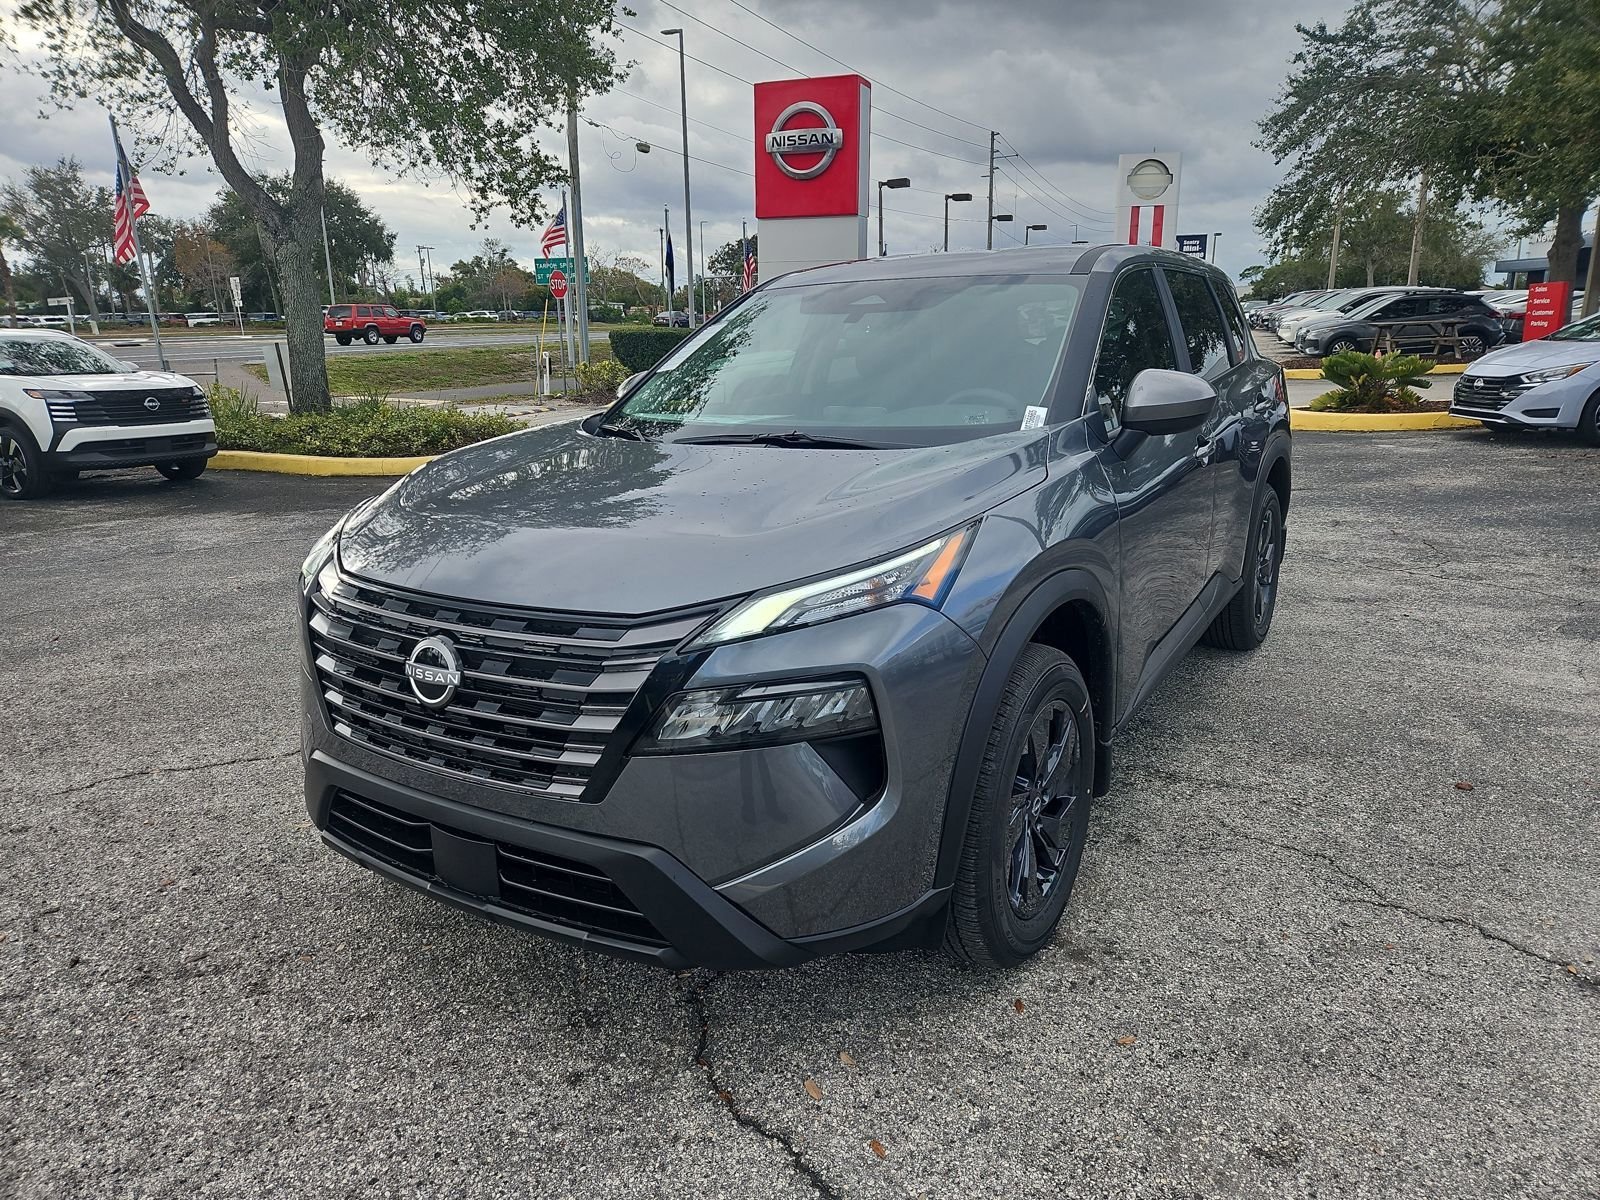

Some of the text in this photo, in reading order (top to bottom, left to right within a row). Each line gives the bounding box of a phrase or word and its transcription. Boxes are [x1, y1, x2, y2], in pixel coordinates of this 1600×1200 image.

[771, 132, 834, 148] NISSAN
[550, 279, 566, 290] STOP
[405, 663, 458, 684] NISSAN
